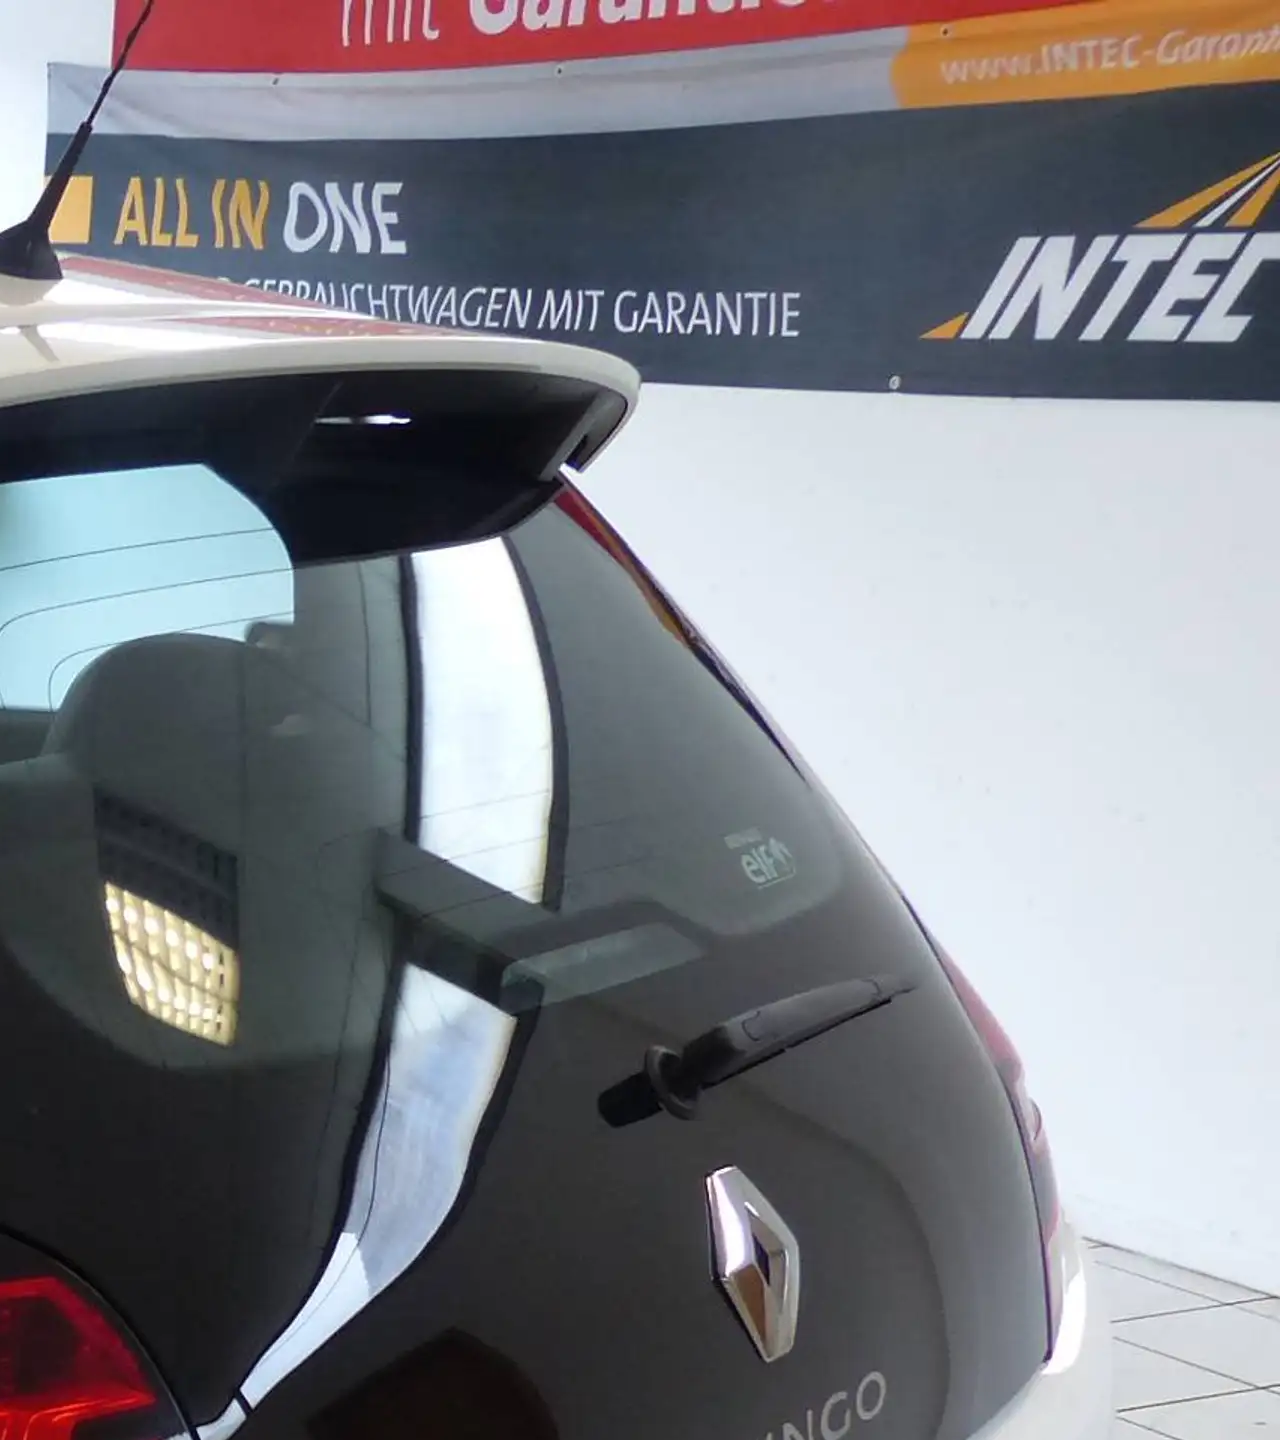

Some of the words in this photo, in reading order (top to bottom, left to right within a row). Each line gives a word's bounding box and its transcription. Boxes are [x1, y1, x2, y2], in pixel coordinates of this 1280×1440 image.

[113, 176, 199, 247] ALL
[212, 178, 271, 249] IN
[283, 181, 407, 254] ONE
[537, 288, 604, 332] MIT
[614, 290, 801, 337] GARANTIE
[960, 232, 1280, 343] INTEC
